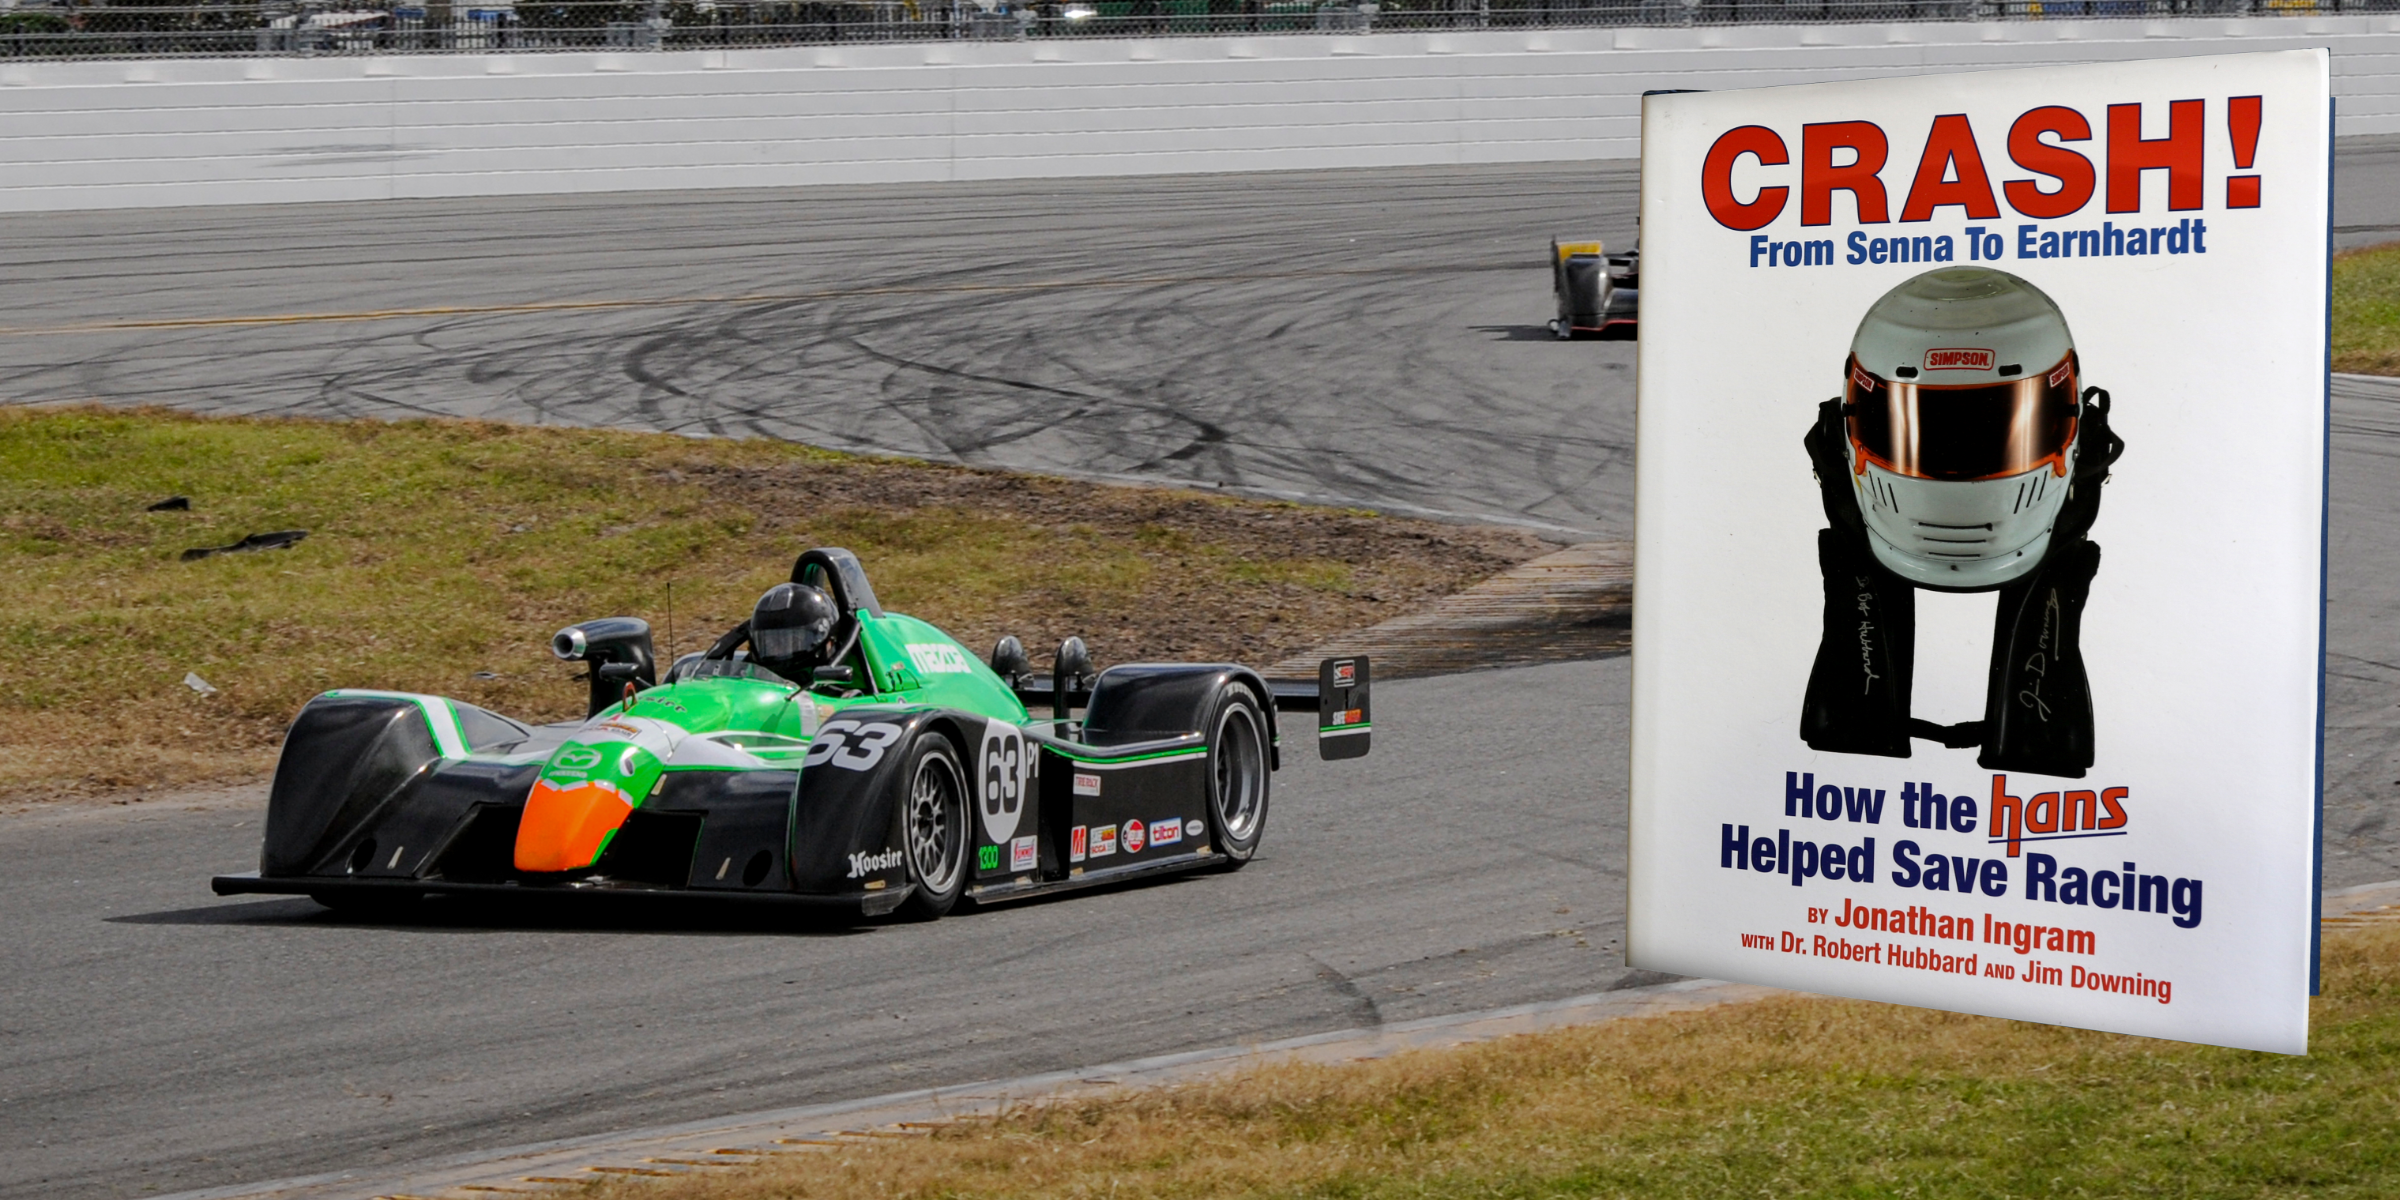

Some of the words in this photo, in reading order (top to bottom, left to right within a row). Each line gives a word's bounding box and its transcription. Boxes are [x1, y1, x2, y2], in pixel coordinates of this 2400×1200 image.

[1701, 95, 2262, 231] CRASH!
[1750, 235, 1834, 268] From
[1846, 230, 1954, 265] Senna
[1965, 226, 2004, 261] To
[2017, 218, 2207, 259] Earnhardt
[1858, 621, 1880, 695] Hubbard
[803, 720, 902, 772] 63
[1027, 742, 1040, 778] P1
[986, 735, 1019, 816] 63
[1153, 825, 1179, 842] tilton
[1785, 772, 1886, 824] How
[1901, 782, 1978, 834] the
[1988, 774, 2129, 858] hans
[847, 847, 903, 878] Hoosier
[978, 845, 1000, 871] 1300
[1721, 824, 1875, 887] Helped
[1892, 840, 2008, 897] Save
[2026, 852, 2204, 929] Racing
[1808, 907, 1829, 925] BY
[1834, 898, 1975, 942] Jonathan
[1983, 914, 2096, 956] Ingram
[1741, 933, 1775, 951] WITH
[1780, 931, 1807, 955] Dr.
[1814, 935, 1882, 965] Robert
[1887, 944, 1978, 976] Hubbard
[1984, 962, 2016, 981] AND
[2021, 960, 2063, 986] Jim
[2071, 965, 2172, 1005] Downing
